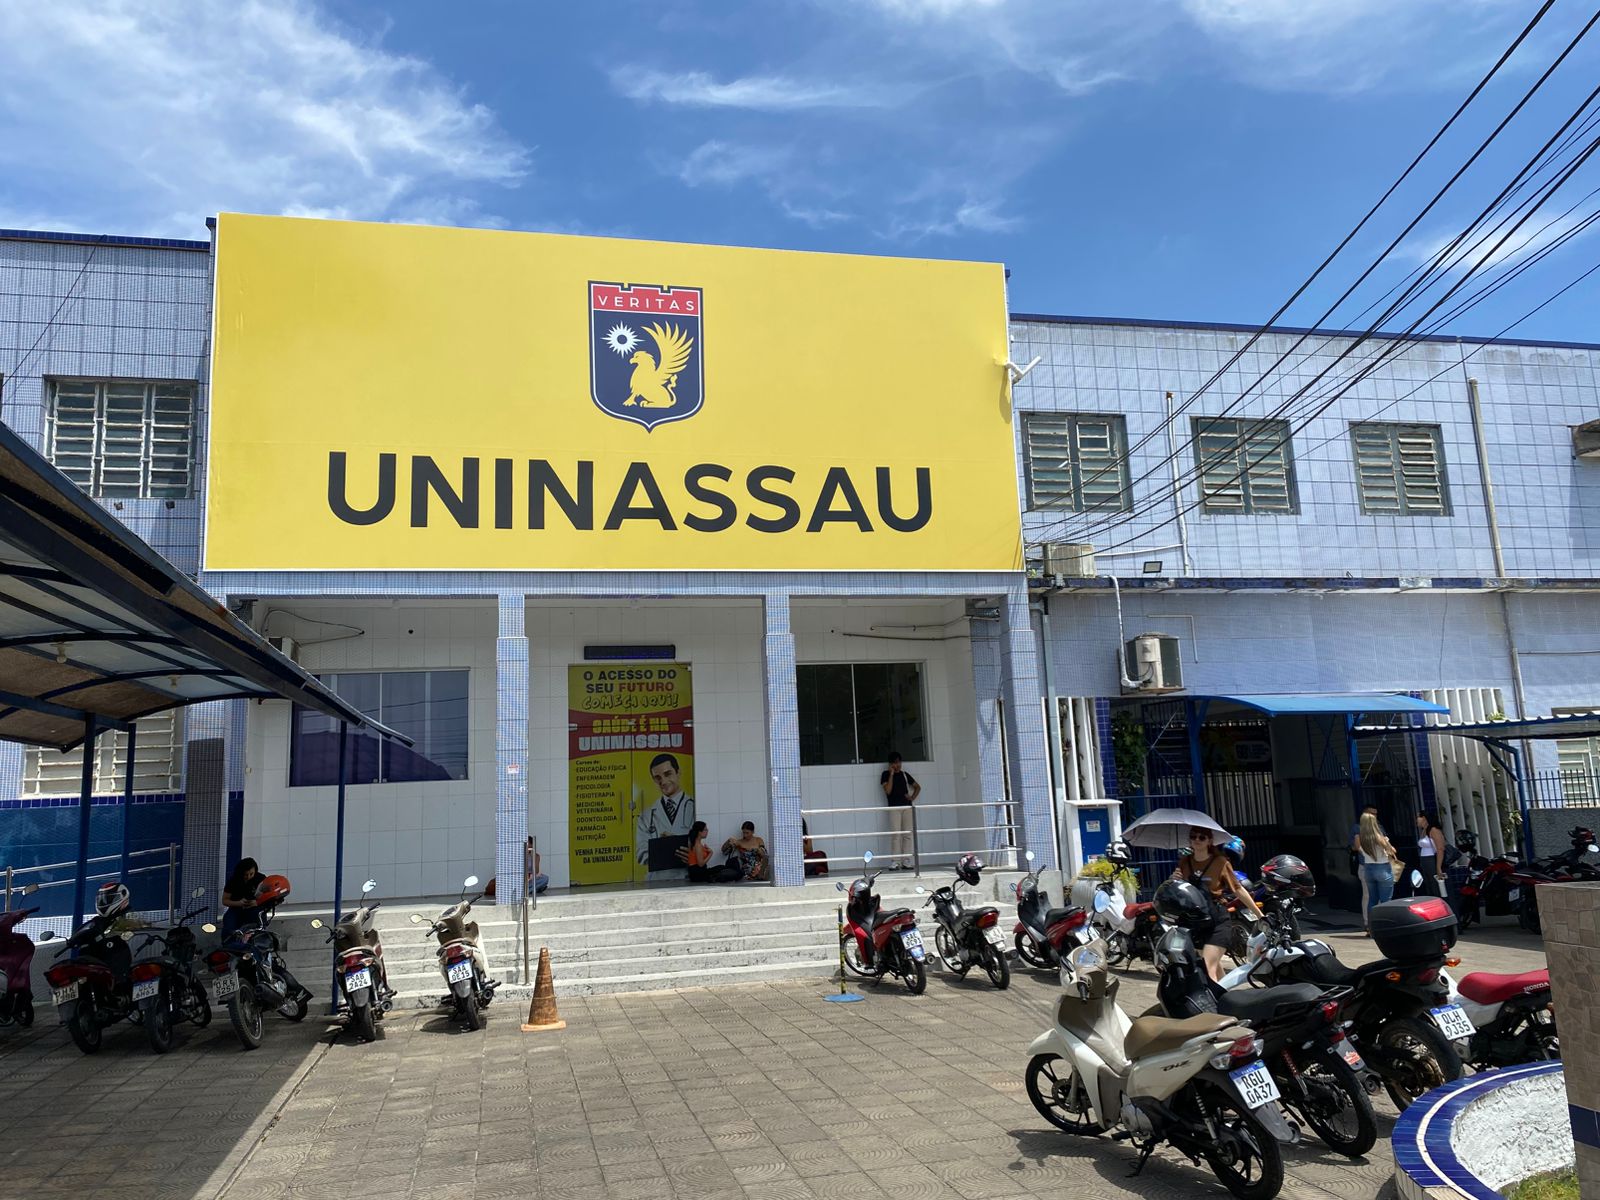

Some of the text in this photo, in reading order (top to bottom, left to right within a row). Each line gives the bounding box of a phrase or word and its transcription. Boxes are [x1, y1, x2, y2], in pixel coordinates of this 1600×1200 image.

[597, 295, 695, 311] VERITAS
[327, 450, 933, 533] UNINASSAU
[583, 669, 677, 681] O ACESSO DO
[586, 681, 674, 693] SEU FUTURO
[578, 733, 683, 752] UNINASSAU
[575, 845, 630, 856] VENHA FAZER PARTE
[1523, 982, 1550, 993] HONDA
[1441, 1010, 1463, 1025] QLH
[1445, 1020, 1471, 1037] 9J35
[1240, 1070, 1265, 1090] RGU
